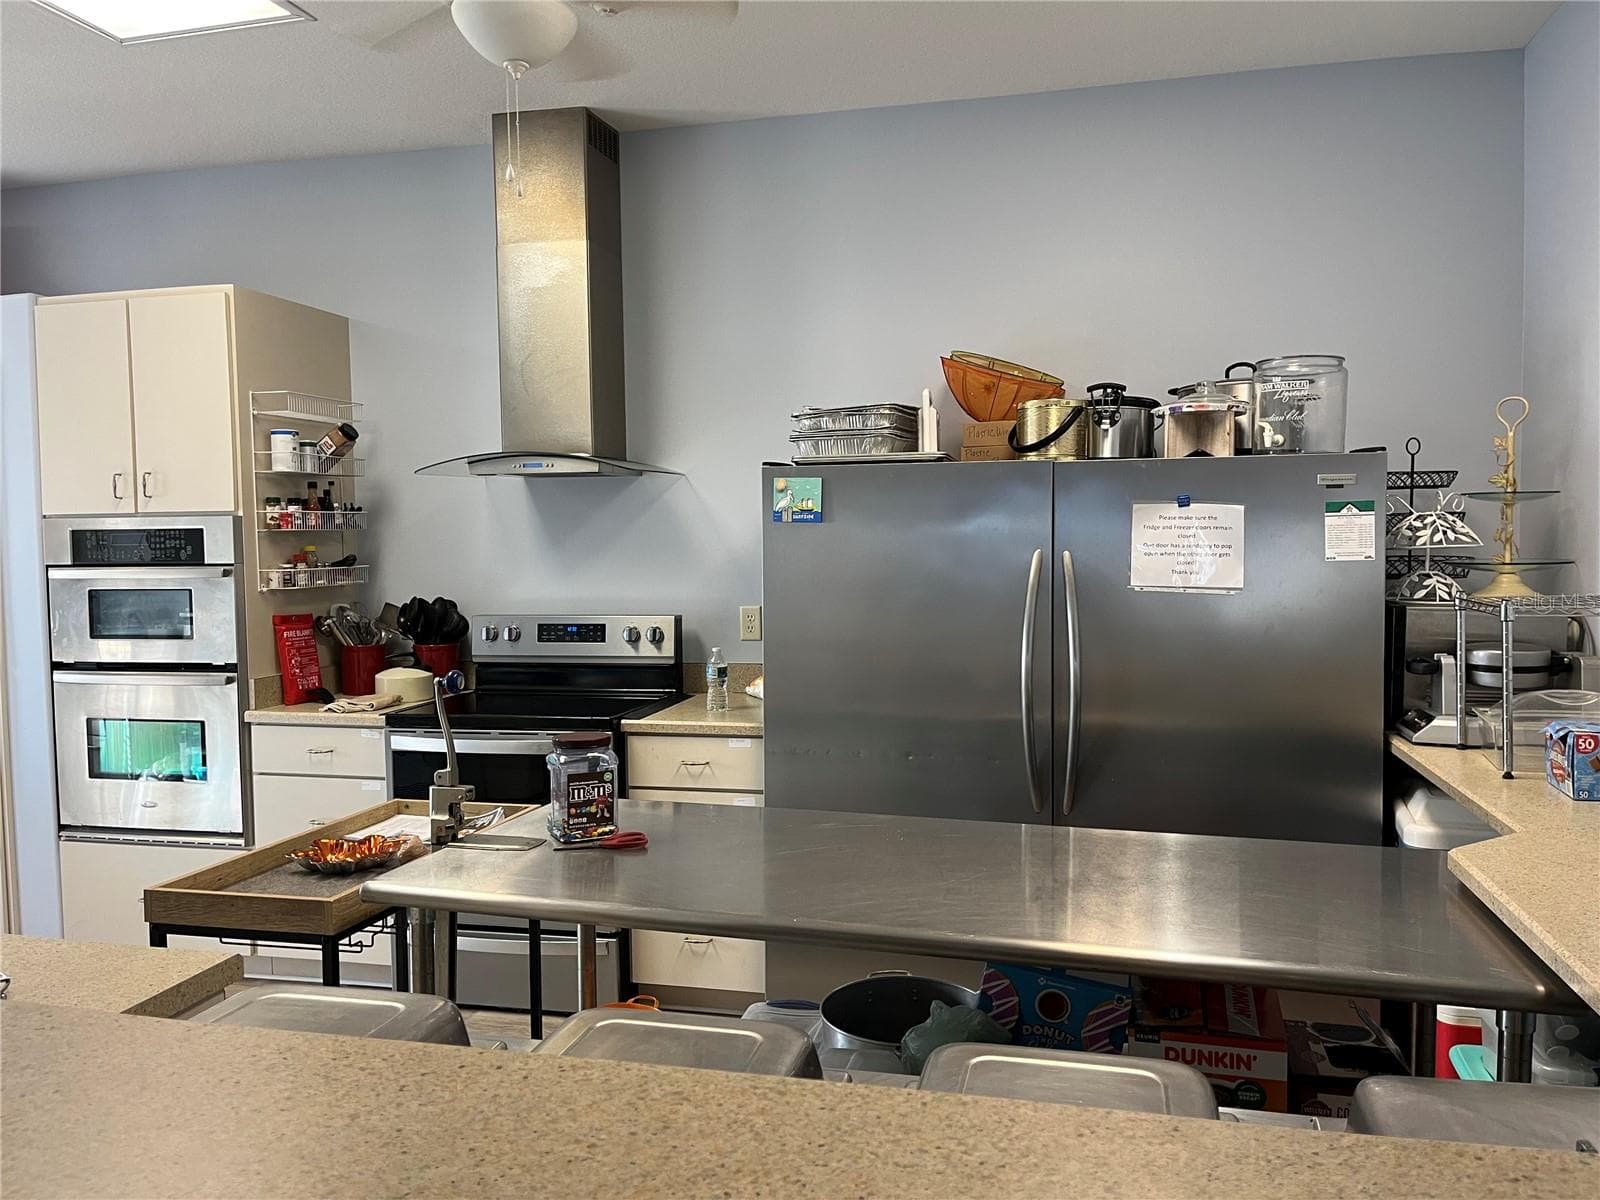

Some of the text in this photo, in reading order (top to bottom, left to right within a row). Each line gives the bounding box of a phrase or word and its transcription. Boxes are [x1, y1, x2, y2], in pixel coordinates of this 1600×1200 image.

[1273, 381, 1308, 390] WALKER
[1578, 738, 1595, 750] 50
[1579, 791, 1589, 799] 50
[1022, 1024, 1075, 1045] DONUT
[1163, 1046, 1258, 1072] DUNKIN'
